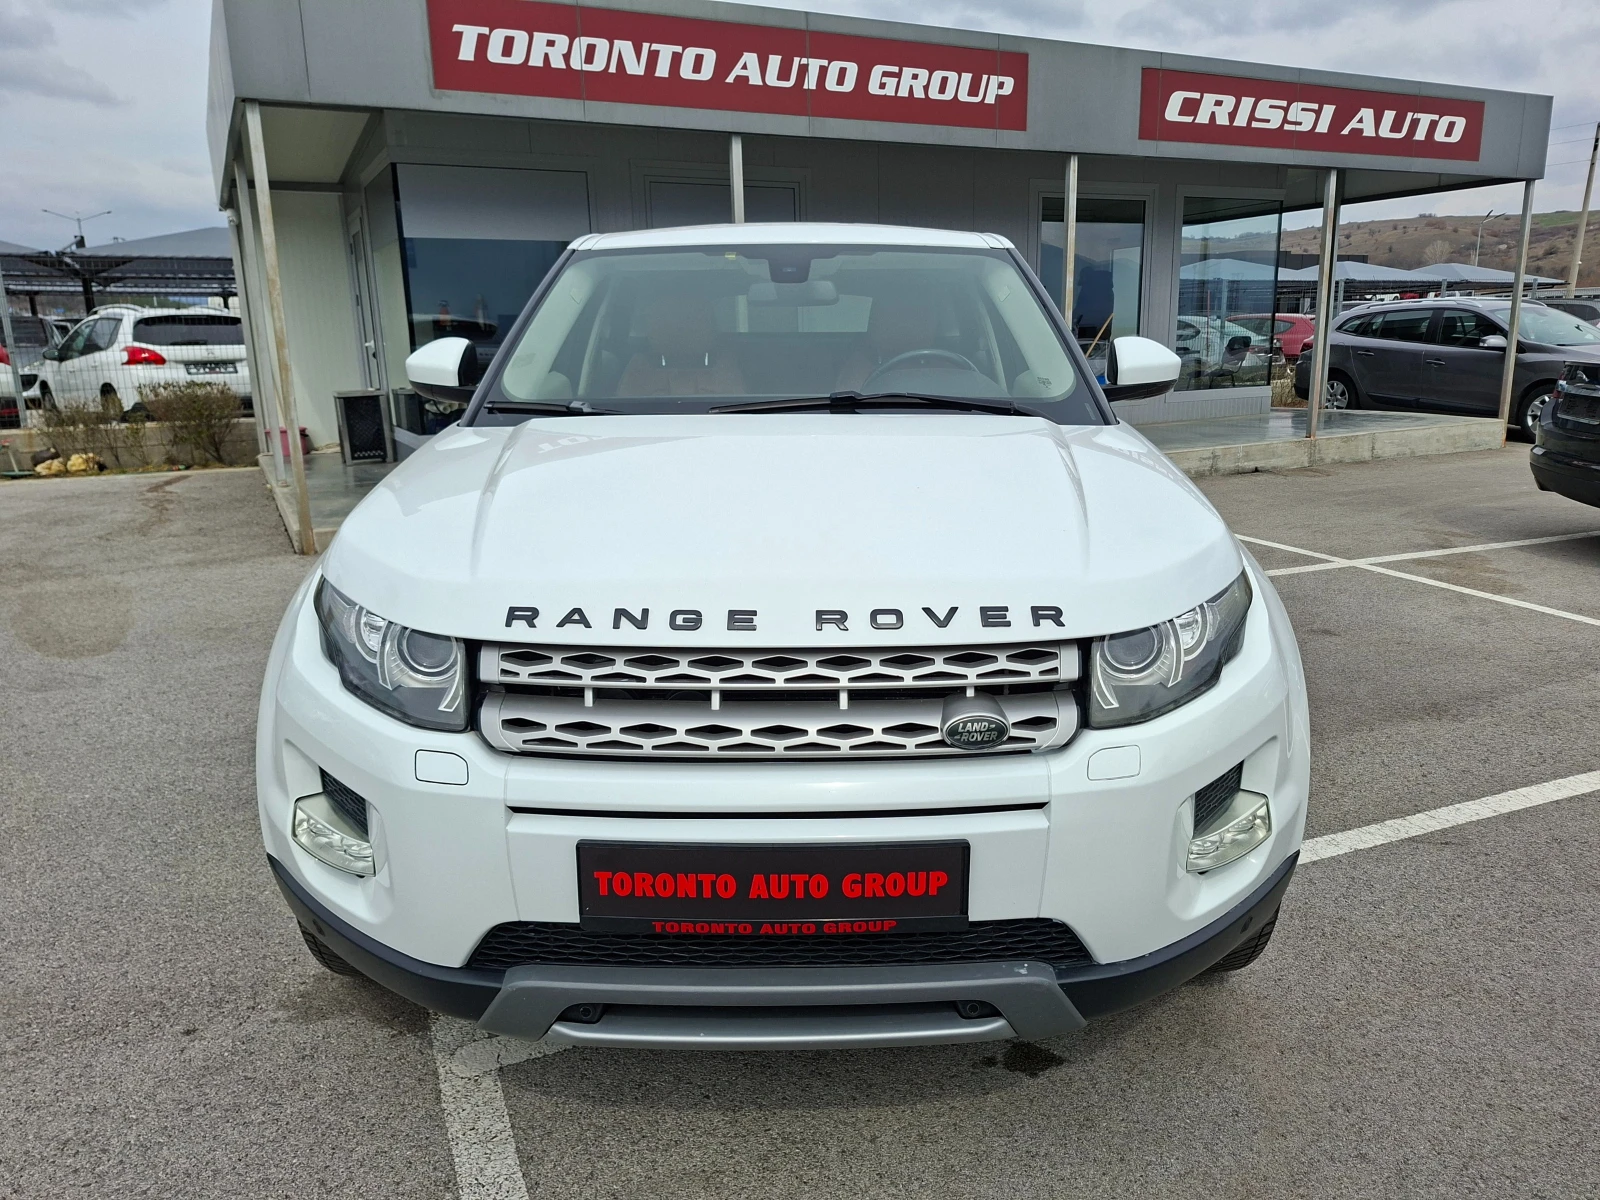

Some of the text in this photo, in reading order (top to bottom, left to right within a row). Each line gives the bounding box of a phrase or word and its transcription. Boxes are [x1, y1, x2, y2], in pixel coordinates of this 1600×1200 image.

[451, 23, 1015, 105] TORONTO AUTO GROUP
[1164, 90, 1467, 143] CRISSI AUTO
[504, 605, 1066, 632] RANGE ROVER
[958, 722, 989, 732] LAND
[961, 731, 998, 742] ROVER
[593, 870, 949, 899] TORONTO AUTO GROUP
[652, 920, 897, 935] TORONTO AUTO GROUP
